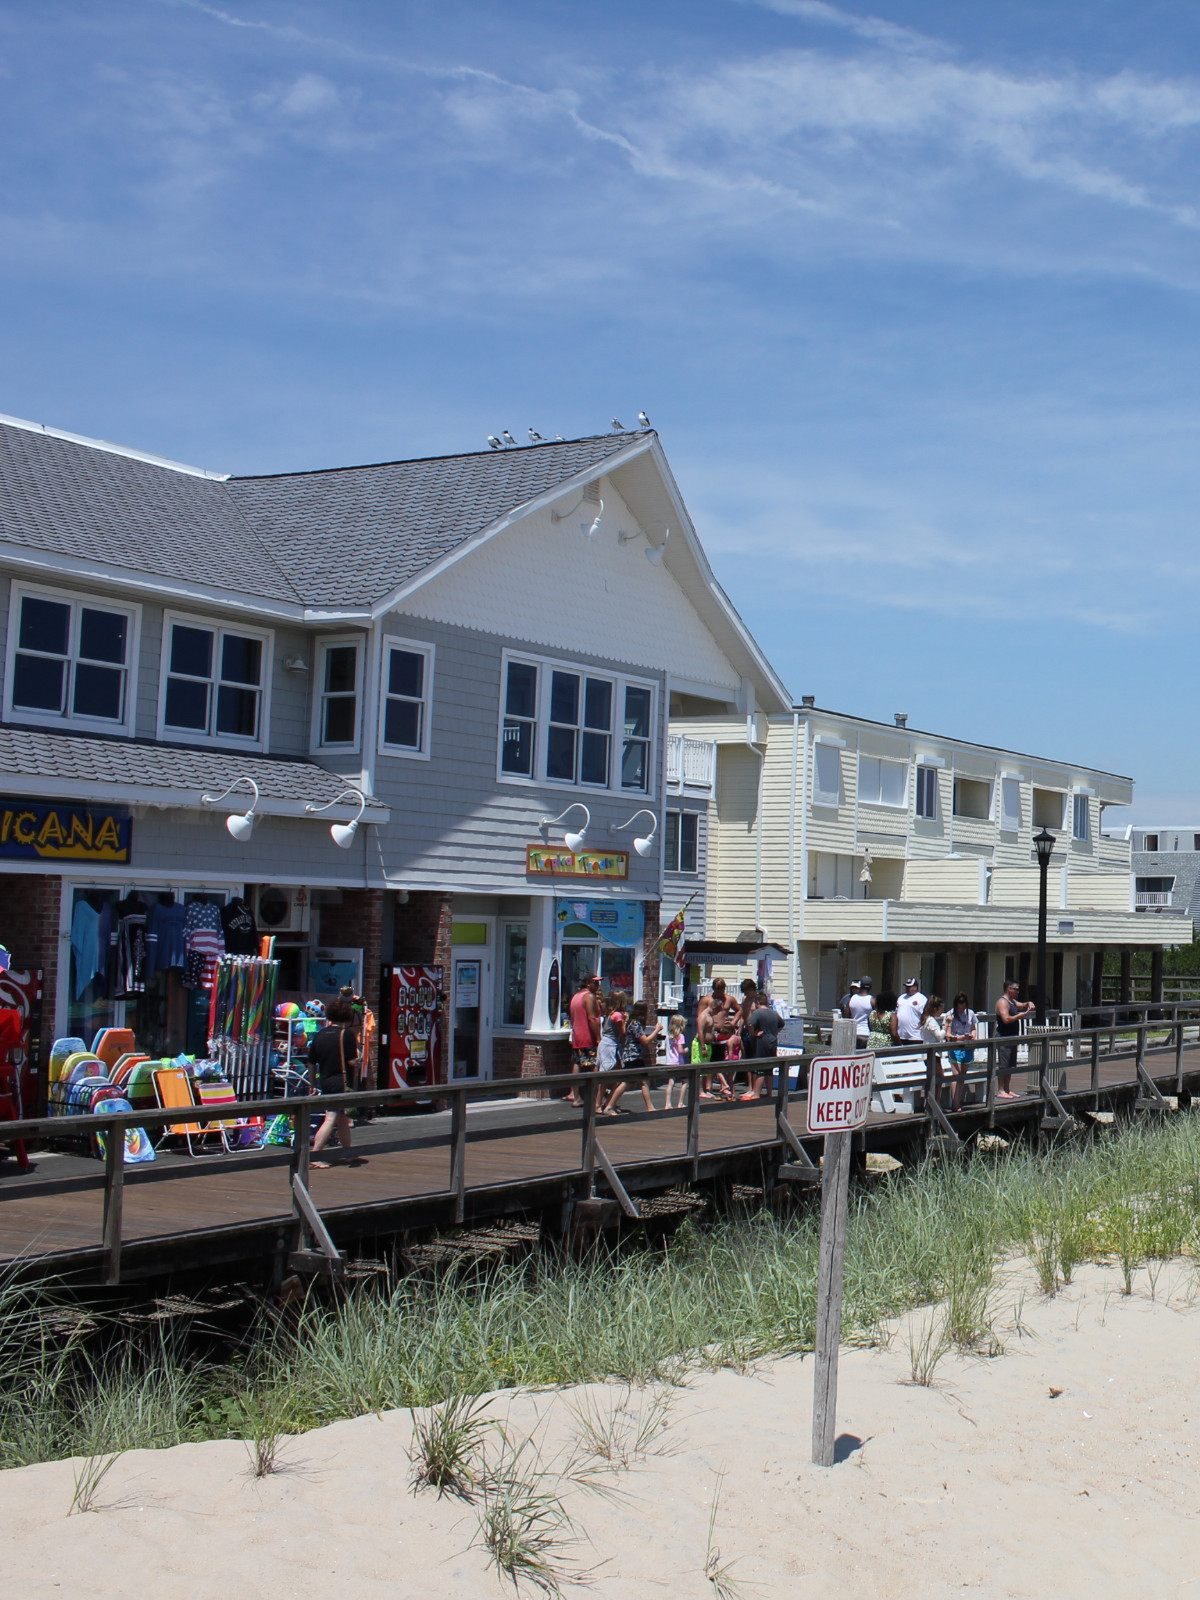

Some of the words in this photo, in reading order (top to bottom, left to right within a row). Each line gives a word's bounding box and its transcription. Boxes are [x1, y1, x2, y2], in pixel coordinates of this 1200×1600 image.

[530, 851, 576, 874] Tropical
[579, 854, 614, 876] Treats
[820, 1063, 870, 1090] DANGER
[817, 1100, 852, 1122] KEEP
[854, 1096, 867, 1119] OUT
